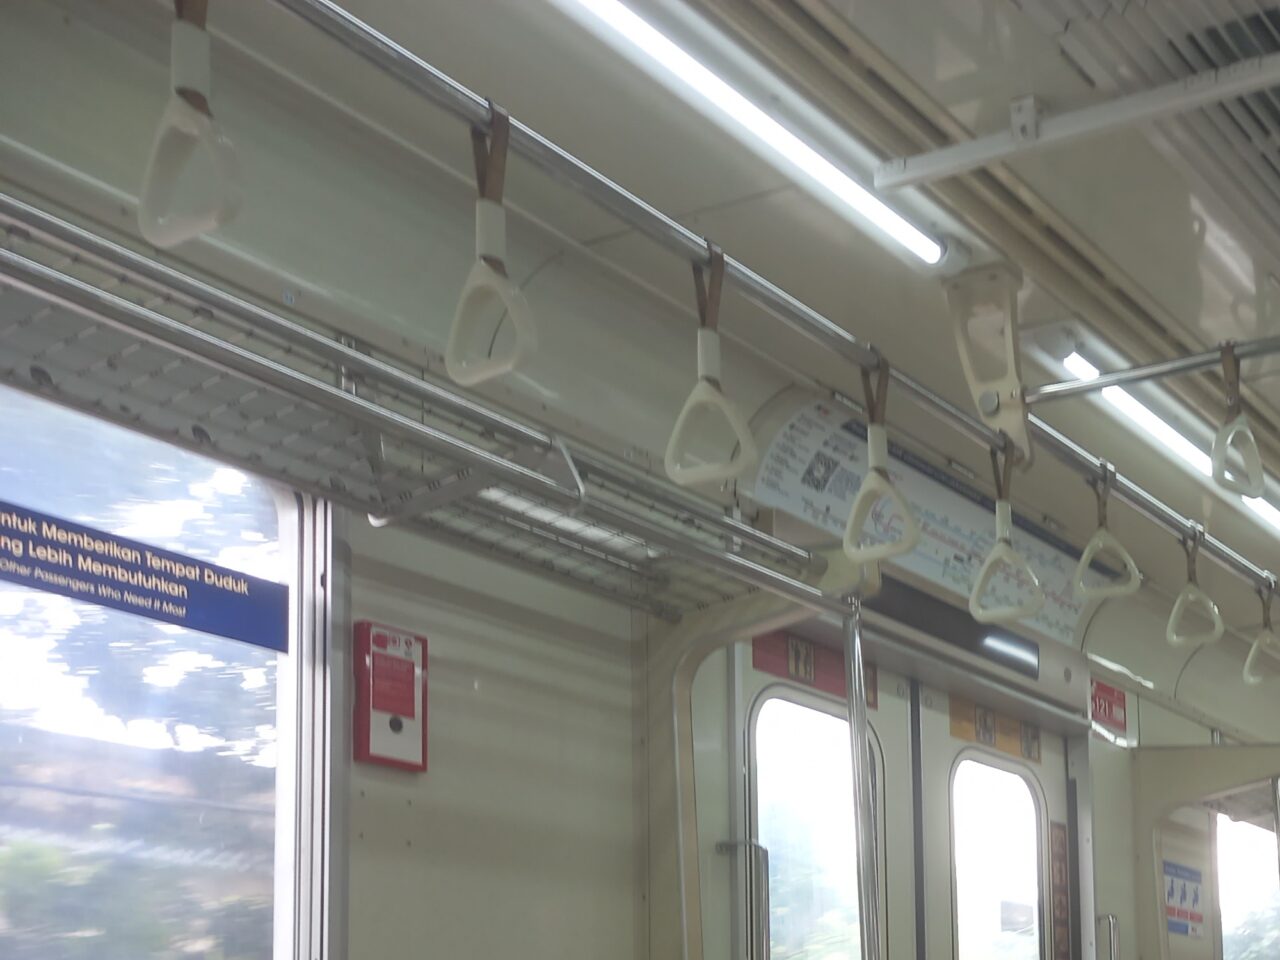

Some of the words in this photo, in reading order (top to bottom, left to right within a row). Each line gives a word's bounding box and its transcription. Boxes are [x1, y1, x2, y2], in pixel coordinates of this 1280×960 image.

[0, 512, 37, 536] ntuk
[42, 521, 141, 565] Memberikan
[145, 550, 200, 581] Tempat
[204, 567, 249, 596] Duduk
[0, 535, 23, 557] ng
[28, 540, 73, 568] Lebih
[78, 553, 188, 599] Membutuhkan
[34, 566, 95, 594] Passengers
[97, 583, 121, 601] Who
[123, 590, 152, 609] Need
[162, 600, 187, 618] Most
